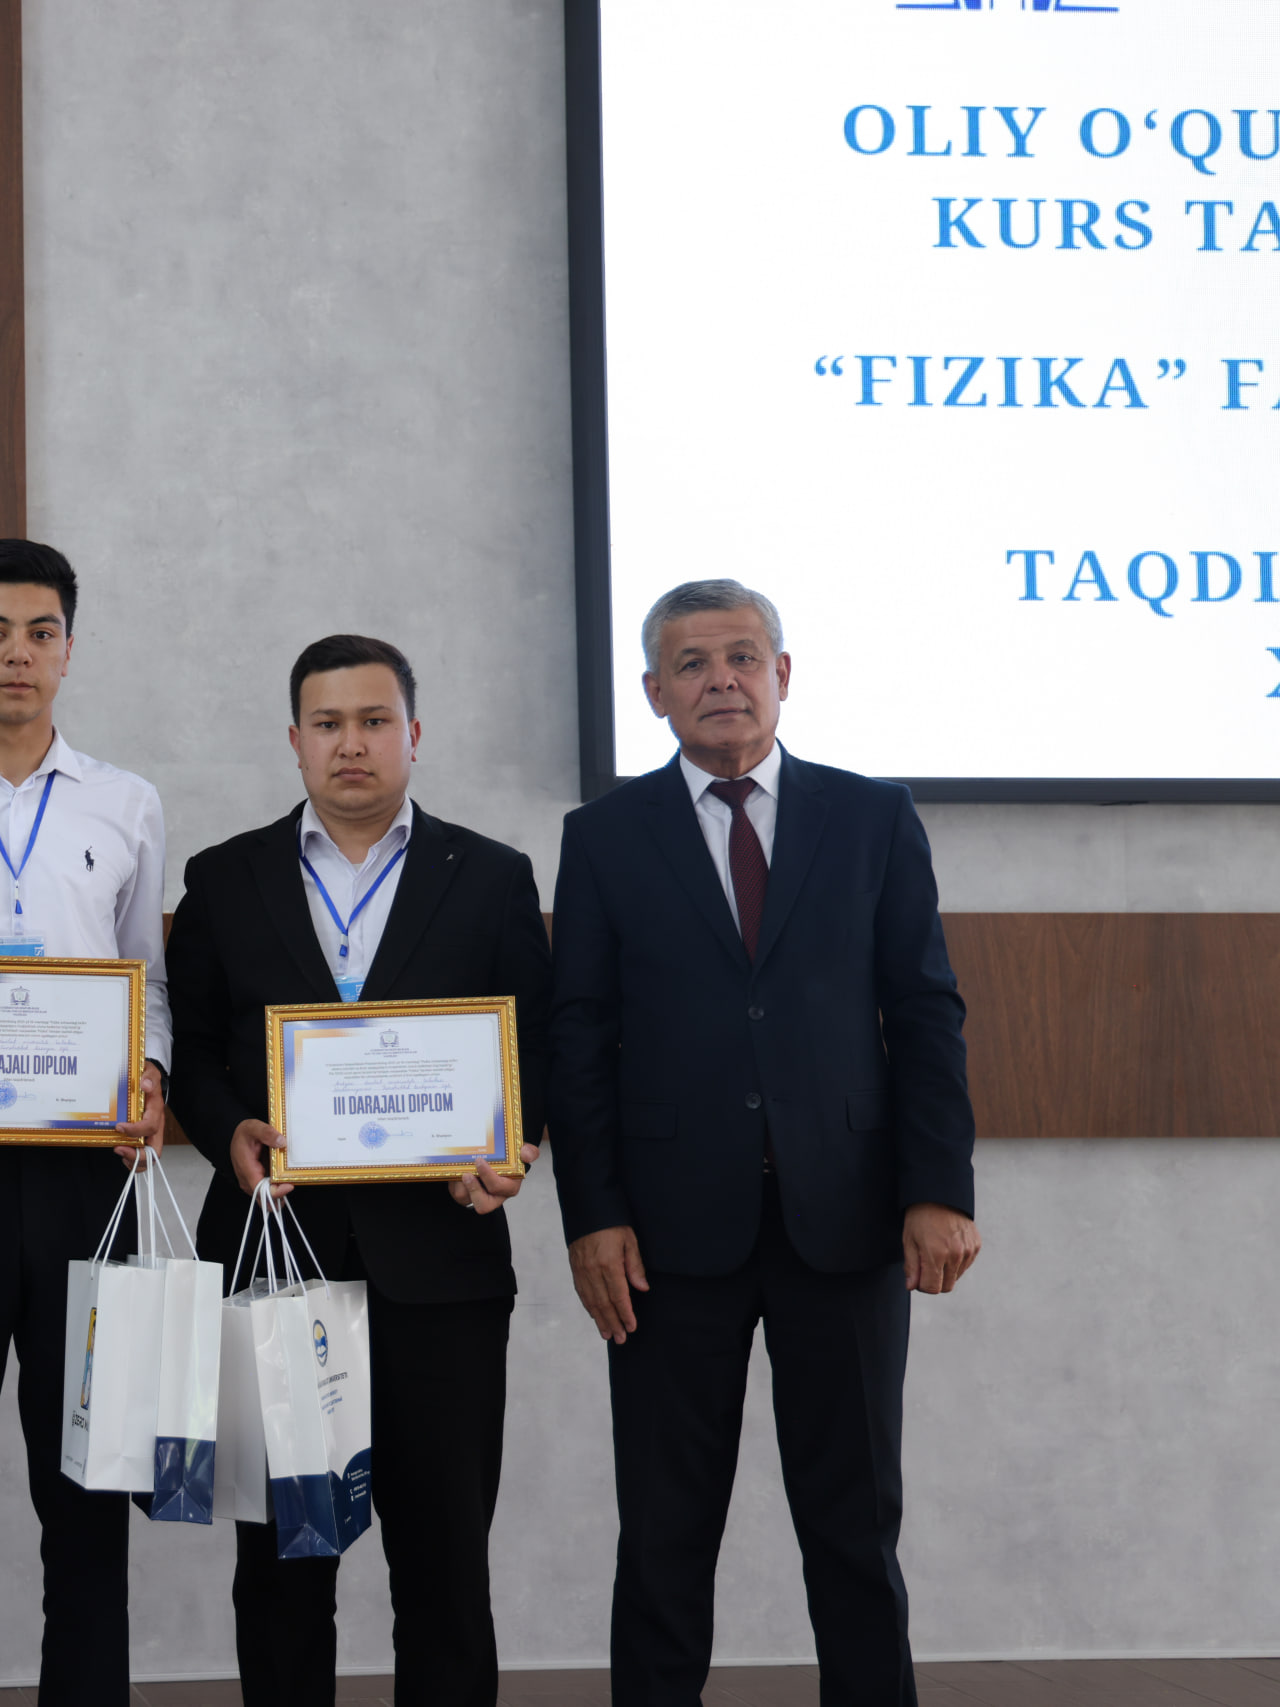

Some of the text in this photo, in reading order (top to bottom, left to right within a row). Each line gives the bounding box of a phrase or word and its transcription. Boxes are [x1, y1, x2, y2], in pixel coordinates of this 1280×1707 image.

[843, 104, 1047, 158] OLIY
[931, 197, 1280, 252] KURS TA
[814, 355, 1187, 409] “FIZIKA”
[1006, 549, 1280, 618] TAQDI
[33, 1054, 78, 1076] DIPLOM
[333, 1092, 454, 1115] III DARAJALI DIPLOM
